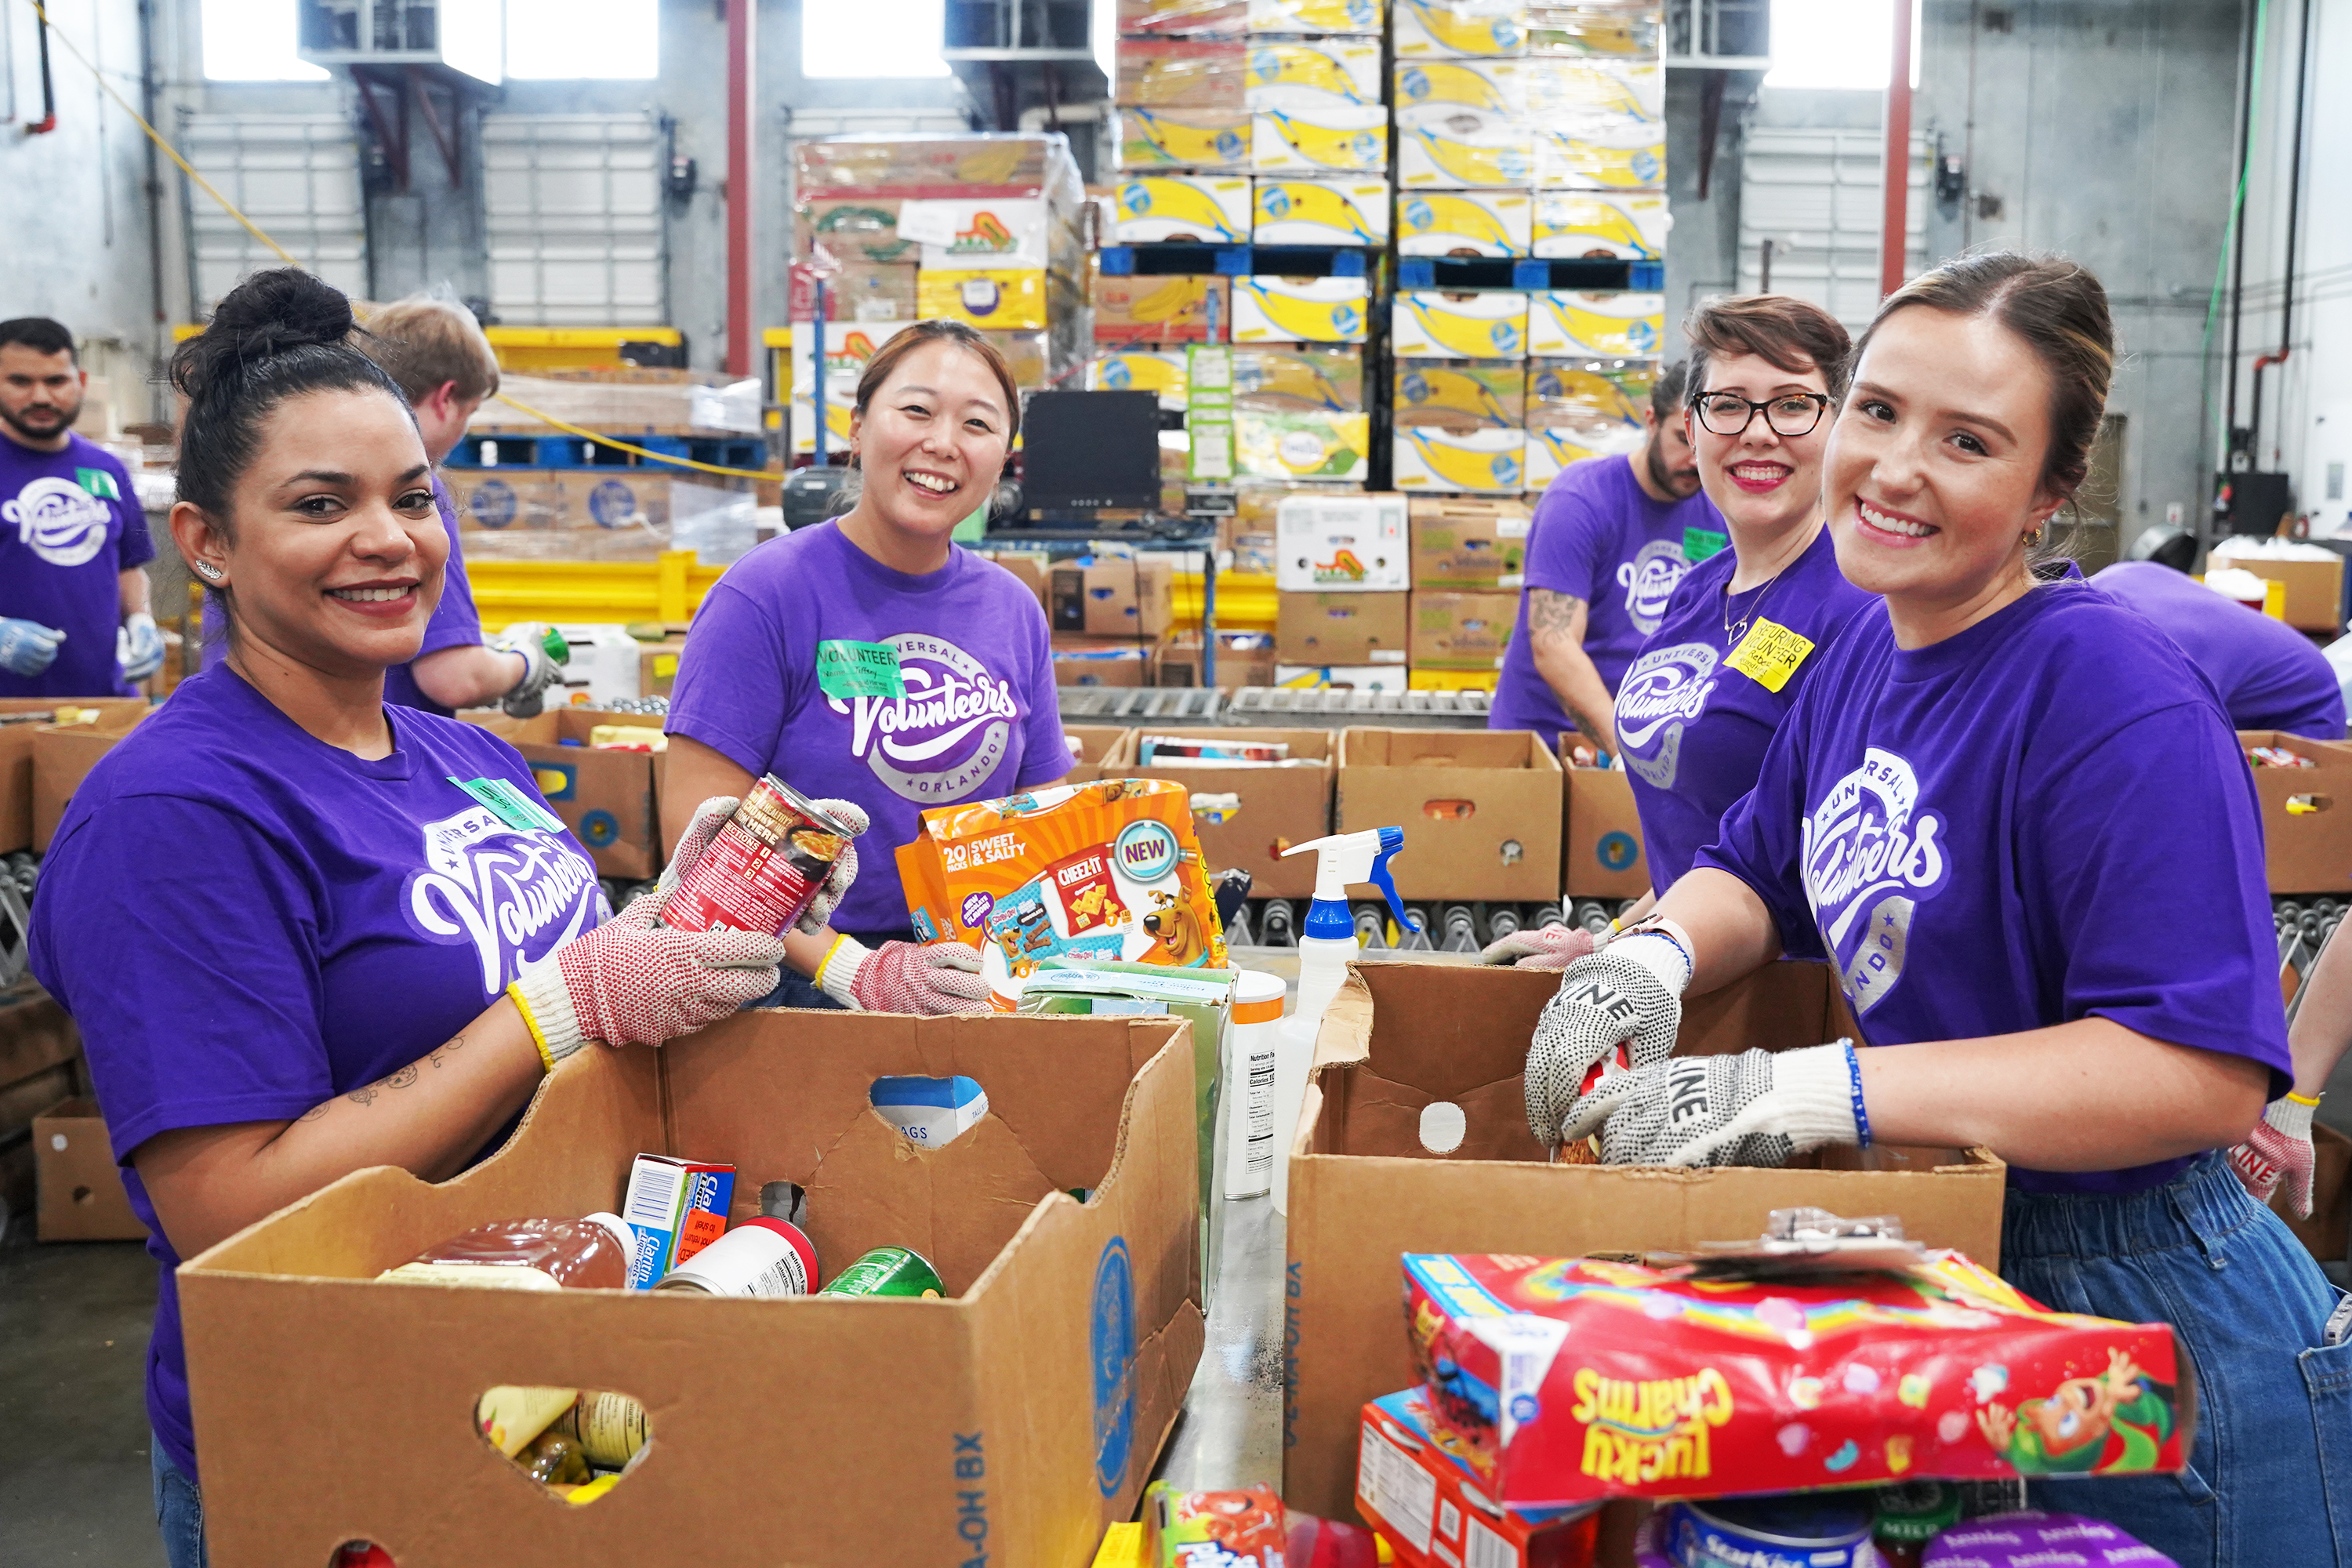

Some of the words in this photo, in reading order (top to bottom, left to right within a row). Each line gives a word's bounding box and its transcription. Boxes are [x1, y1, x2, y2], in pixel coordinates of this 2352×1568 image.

[818, 648, 897, 666] VOLUNTEER
[896, 641, 959, 664] VERSAL
[828, 667, 1017, 757] Volunteers
[919, 743, 998, 793] ORLANDO
[1831, 760, 1904, 809] UNRSAL
[747, 818, 779, 846] HERE
[971, 832, 1014, 854] SWEET
[943, 844, 967, 865] 20
[972, 853, 985, 866] &
[985, 843, 1026, 863] SALTY
[1125, 839, 1164, 863] NEW
[946, 861, 967, 873] PACKS
[411, 829, 597, 995] Volunteers
[964, 895, 978, 910] NEW
[964, 895, 989, 920] CHOCOLATE
[967, 901, 991, 925] FLAVOR!
[943, 917, 956, 940] 20
[1108, 916, 1114, 924] 7
[1020, 967, 1026, 975] 6
[1250, 1053, 1269, 1062] Nutrition
[901, 1126, 927, 1139] AGS
[695, 1220, 709, 1230] shelf
[709, 1225, 716, 1233] to
[684, 1232, 700, 1244] return
[639, 1235, 660, 1283] Claritin
[789, 1250, 804, 1279] Nutrition
[776, 1261, 789, 1288] Calories
[1571, 1367, 1734, 1428] Charms
[953, 1430, 985, 1479] BX
[1580, 1421, 1711, 1485] Lucky
